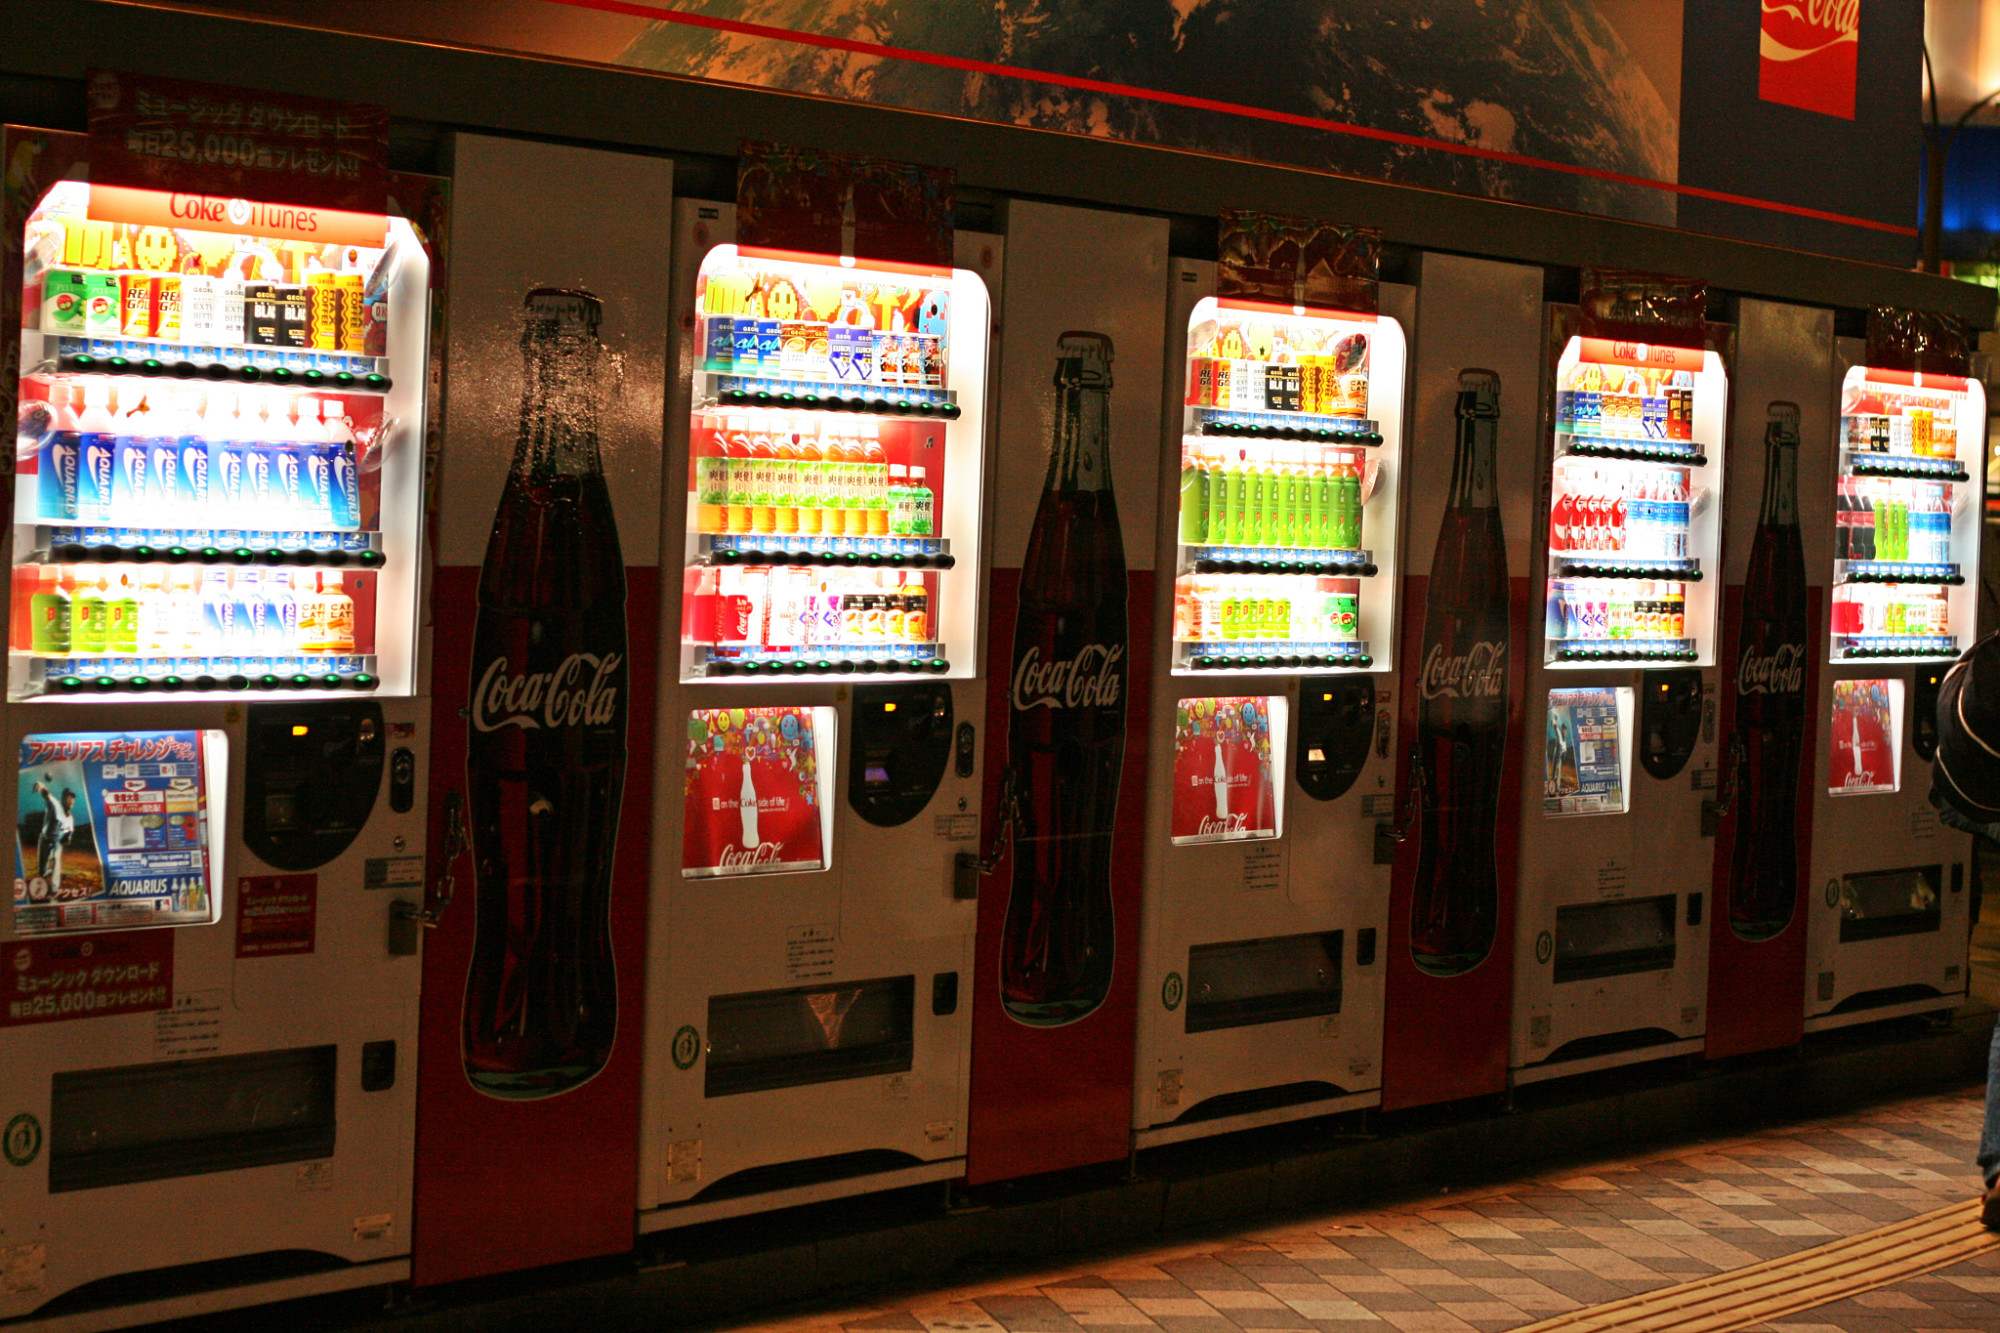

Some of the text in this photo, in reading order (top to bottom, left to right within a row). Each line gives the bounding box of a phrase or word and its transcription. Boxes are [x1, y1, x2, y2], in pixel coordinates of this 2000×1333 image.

[169, 192, 318, 232] Coke iTunes
[1613, 342, 1676, 364] Coke iTunes
[63, 445, 77, 516] AQUARIUS
[473, 652, 623, 732] Coca-Cola
[1013, 643, 1125, 711] Coca-Cola
[1422, 641, 1507, 700] Coca-Cola
[1738, 643, 1806, 696] Coca-Cola
[28, 738, 172, 764] アクエリアス チャレンジ
[1581, 782, 1607, 795] AQUARIUS
[109, 878, 168, 896] AQUARIUS
